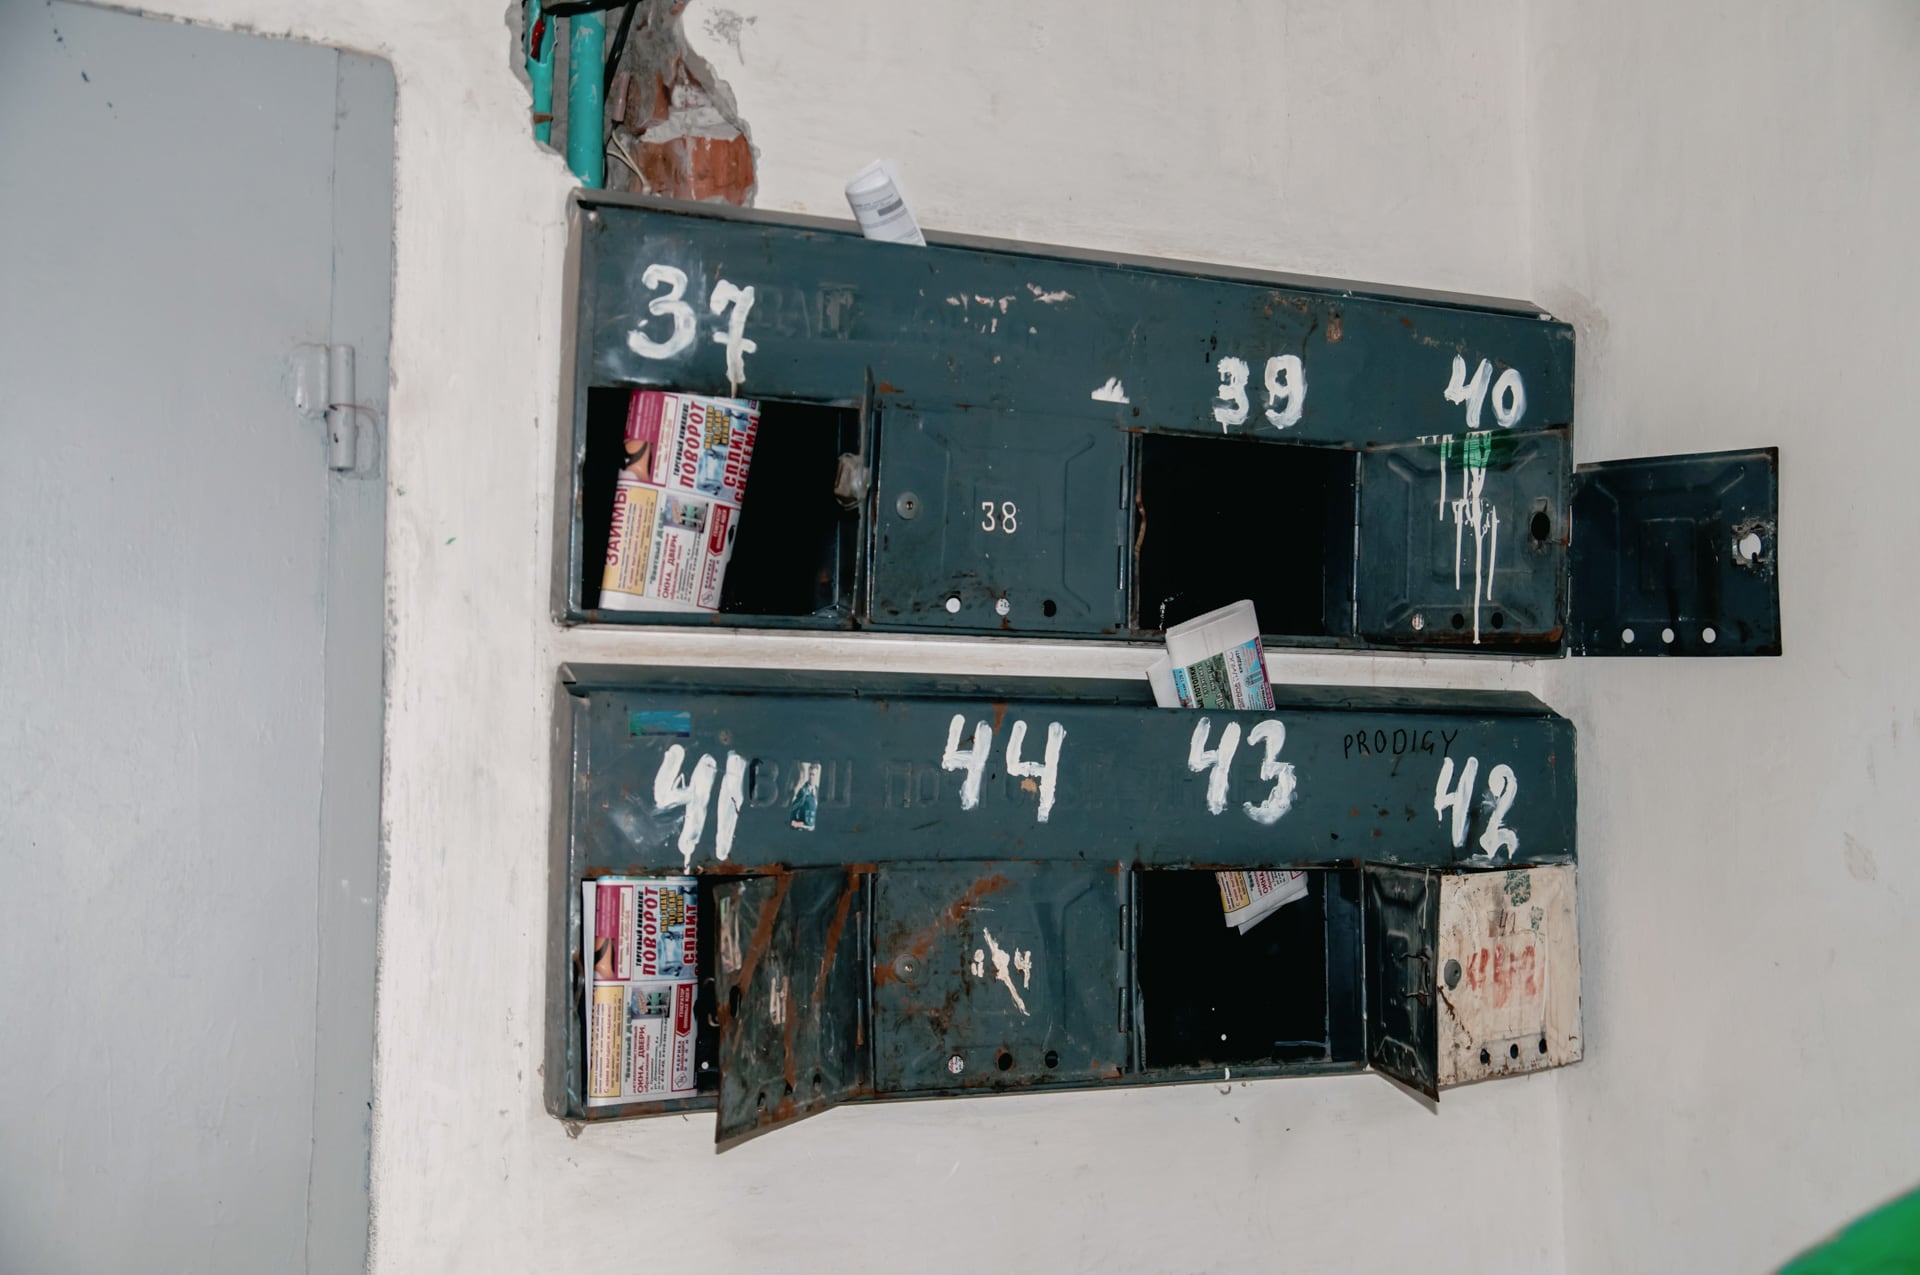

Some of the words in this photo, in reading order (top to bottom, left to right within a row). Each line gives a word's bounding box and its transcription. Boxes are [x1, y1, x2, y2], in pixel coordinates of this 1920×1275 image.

[626, 264, 757, 390] 37
[1211, 353, 1308, 432] 39
[1443, 354, 1527, 430] 40
[679, 401, 705, 487] ПОВОРОТ
[723, 428, 745, 487] СПЛИТ
[733, 415, 759, 502] СИСТЕМЫ
[981, 501, 1018, 534] 38
[1188, 666, 1201, 697] ПОТОЛКИ
[942, 714, 1066, 823] 44
[1188, 717, 1297, 825] 43
[1344, 728, 1459, 760] PRODIGY
[654, 743, 748, 868] 41
[1434, 757, 1519, 860] 42
[642, 886, 657, 975] ПОВОРОТ
[659, 887, 667, 914] ЗНАЕМ
[660, 916, 667, 932] МЫ
[683, 903, 696, 964] СПЛИТ
